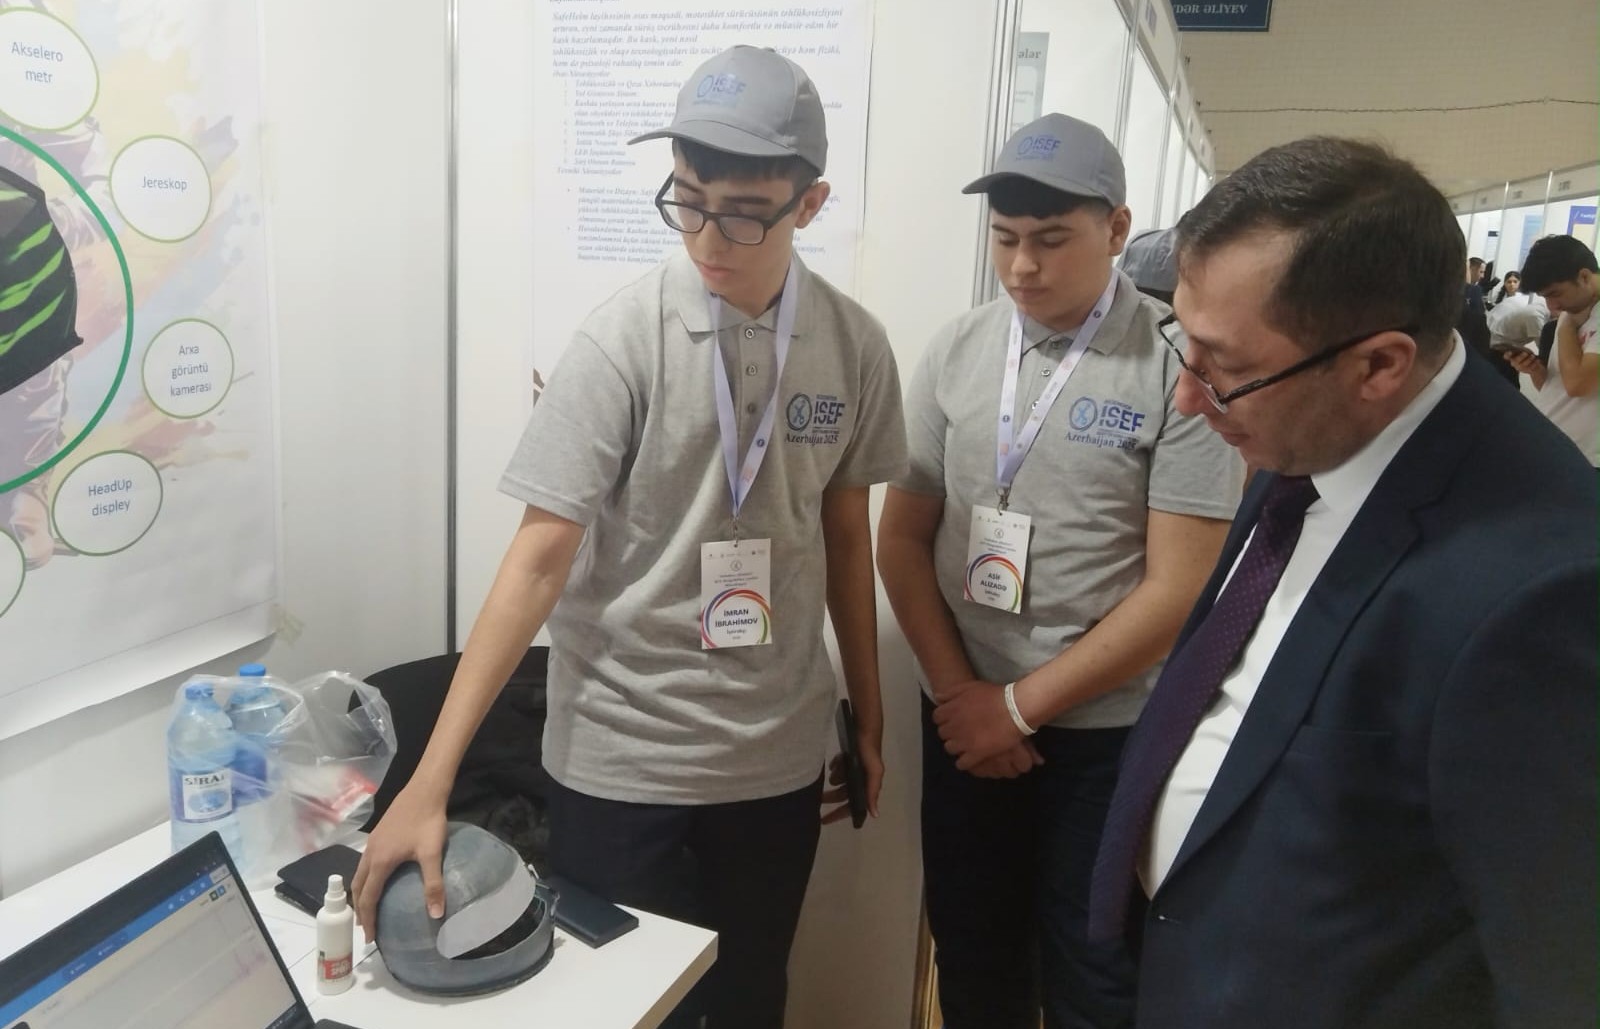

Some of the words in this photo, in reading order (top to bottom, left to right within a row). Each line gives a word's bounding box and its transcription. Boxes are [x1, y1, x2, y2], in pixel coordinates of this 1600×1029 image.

[11, 41, 64, 62] Akselero
[25, 69, 53, 83] metr
[1032, 136, 1062, 152] ISEF
[142, 175, 188, 192] Jereskop
[178, 344, 200, 356] Arxa
[171, 362, 209, 379] görüntü
[170, 382, 212, 396] kamerası
[813, 401, 845, 425] ISEF
[1099, 405, 1145, 432] ISEF
[1065, 432, 1115, 448] Azerbaijan
[88, 478, 133, 497] HeadUp
[91, 500, 131, 518] displey
